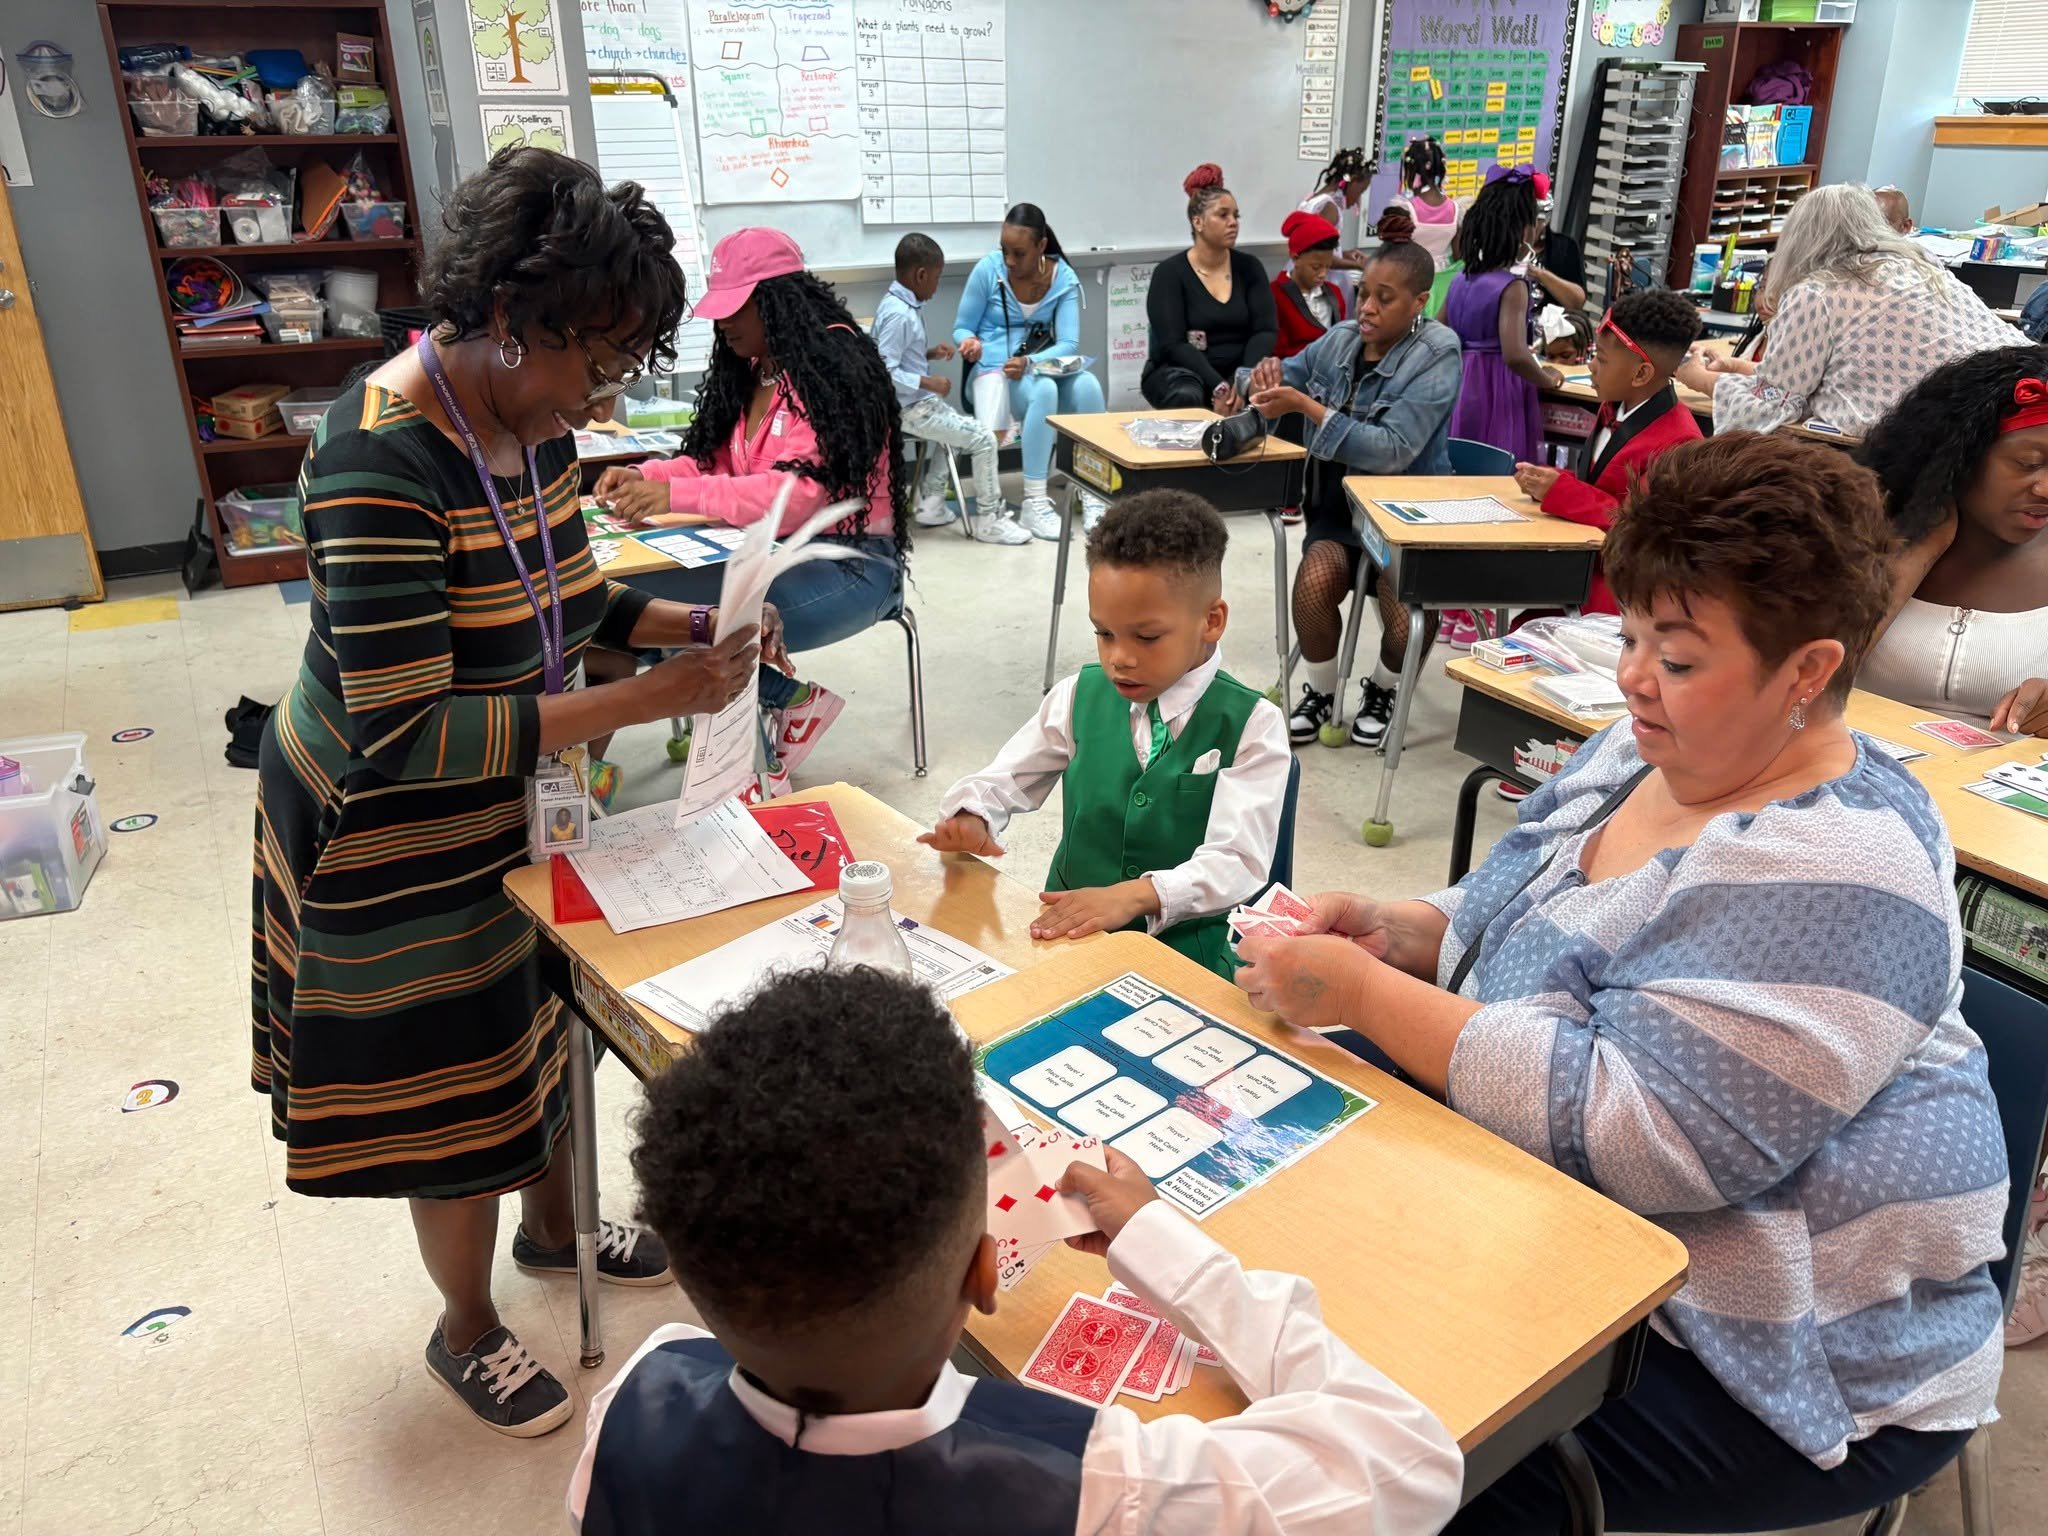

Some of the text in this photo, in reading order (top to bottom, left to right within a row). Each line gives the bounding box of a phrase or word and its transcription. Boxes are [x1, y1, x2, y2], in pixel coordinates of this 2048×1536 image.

[581, 1, 600, 11] ore
[708, 10, 764, 25] Parallelogram
[787, 9, 831, 24] Trapezoid
[599, 22, 662, 43] dog dogs
[857, 17, 993, 39] What do plants need to grow?
[1420, 14, 1538, 46] Word Wall
[598, 46, 687, 60] church churches
[517, 115, 553, 125] Spellings
[1112, 339, 1134, 350] Count
[1112, 351, 1145, 360] numbers
[434, 372, 444, 386] OLD
[441, 385, 453, 406] NORTH
[451, 405, 469, 432] ACADEMY
[542, 783, 559, 793] CA
[1084, 1043, 1120, 1067] Hundreds
[1104, 1041, 1125, 1055] Ones
[1193, 1045, 1224, 1064] Place Cards
[1207, 1045, 1222, 1055] Here
[1063, 1063, 1081, 1075] Player
[1189, 1057, 1206, 1069] Player
[1045, 1067, 1074, 1088] Place Cards
[1046, 1076, 1059, 1087] Here
[1246, 1073, 1279, 1094] Place Cards
[1261, 1074, 1276, 1085] Here
[1113, 1093, 1131, 1106] Player
[1244, 1087, 1262, 1100] Player
[1095, 1099, 1126, 1119] Place Cards
[1096, 1108, 1110, 1118] Here
[1048, 1131, 1062, 1145] 5
[1166, 1125, 1184, 1139] Player
[1082, 1137, 1097, 1150] 3
[1147, 1131, 1180, 1154] Place Cards
[1148, 1141, 1164, 1153] Here
[1182, 1171, 1196, 1181] Place
[1195, 1179, 1209, 1190] Value
[1176, 1176, 1212, 1201] Tens, Ones
[1172, 1184, 1206, 1208] Hundreds
